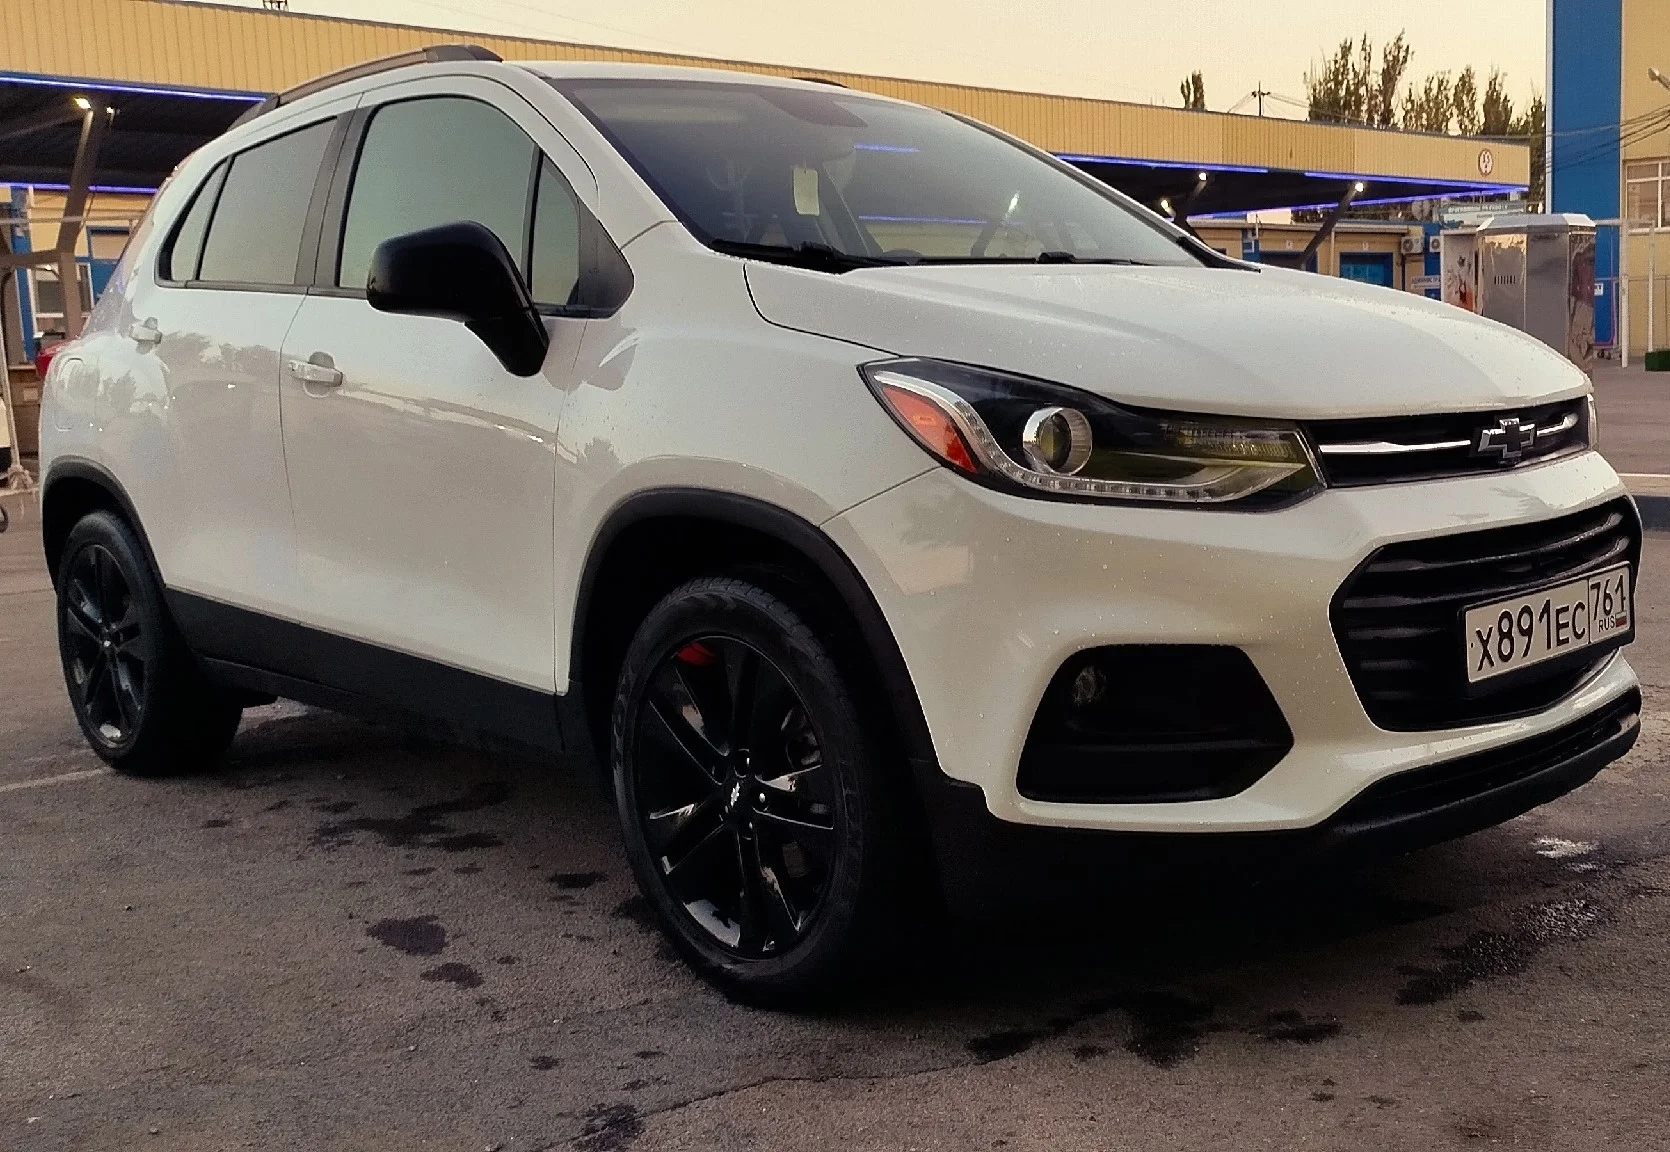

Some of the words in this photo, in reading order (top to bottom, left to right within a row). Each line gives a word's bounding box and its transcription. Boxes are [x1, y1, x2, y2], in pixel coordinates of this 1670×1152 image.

[1475, 599, 1586, 672] X891EC
[1590, 574, 1626, 621] 761
[1598, 615, 1616, 633] RUS
